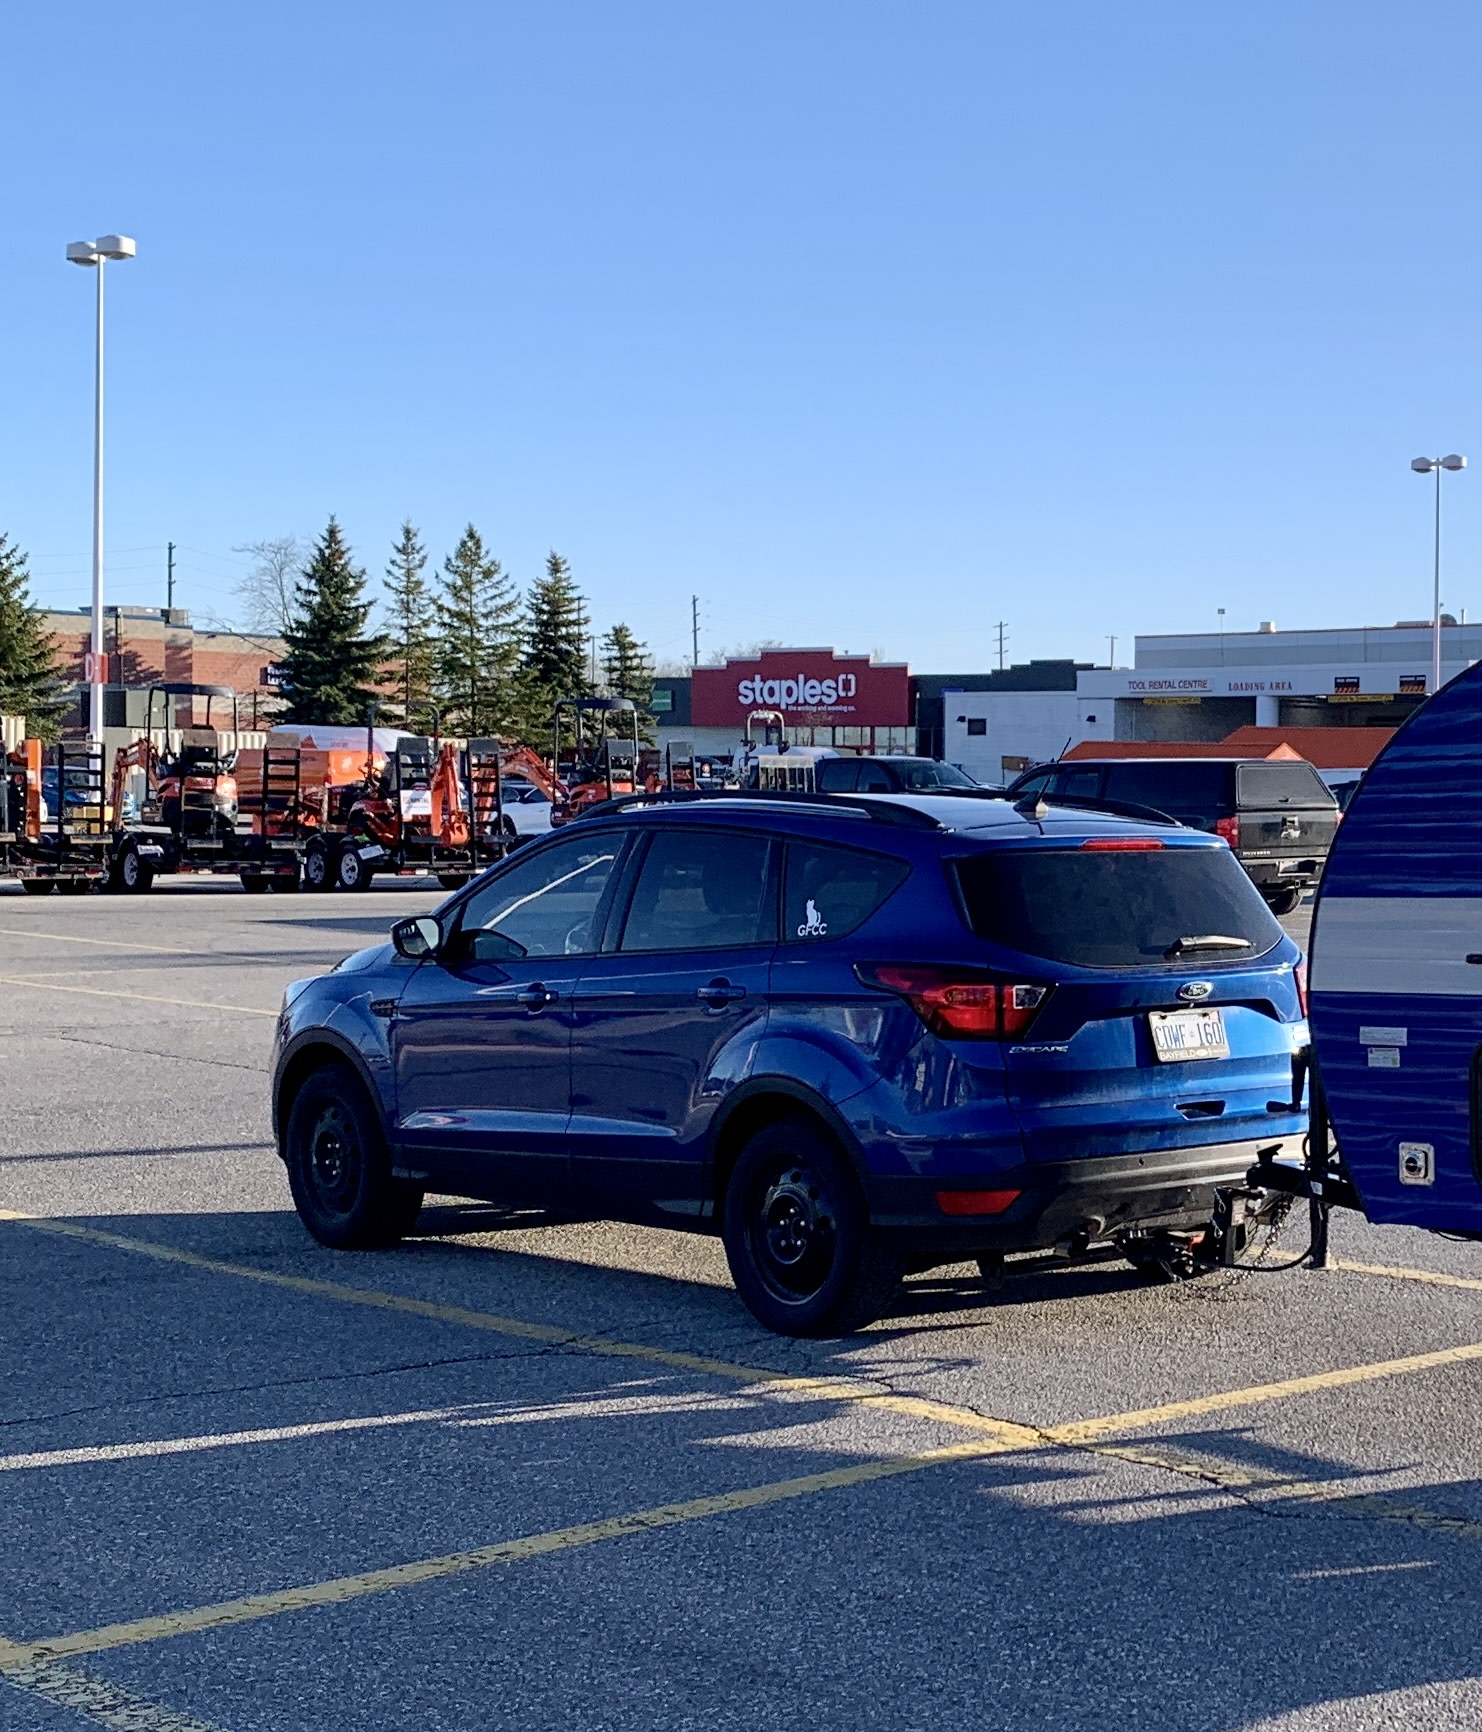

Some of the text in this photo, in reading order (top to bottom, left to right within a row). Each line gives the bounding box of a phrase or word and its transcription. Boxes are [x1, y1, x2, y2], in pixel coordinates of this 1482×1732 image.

[1128, 679, 1208, 690] TOOL RENTAL CENTRE
[1228, 681, 1293, 692] LOADING AREA
[738, 673, 838, 711] staples
[797, 922, 828, 937] GFCC
[1155, 1024, 1186, 1049] CDWF
[1160, 1049, 1196, 1060] BAYFIELD
